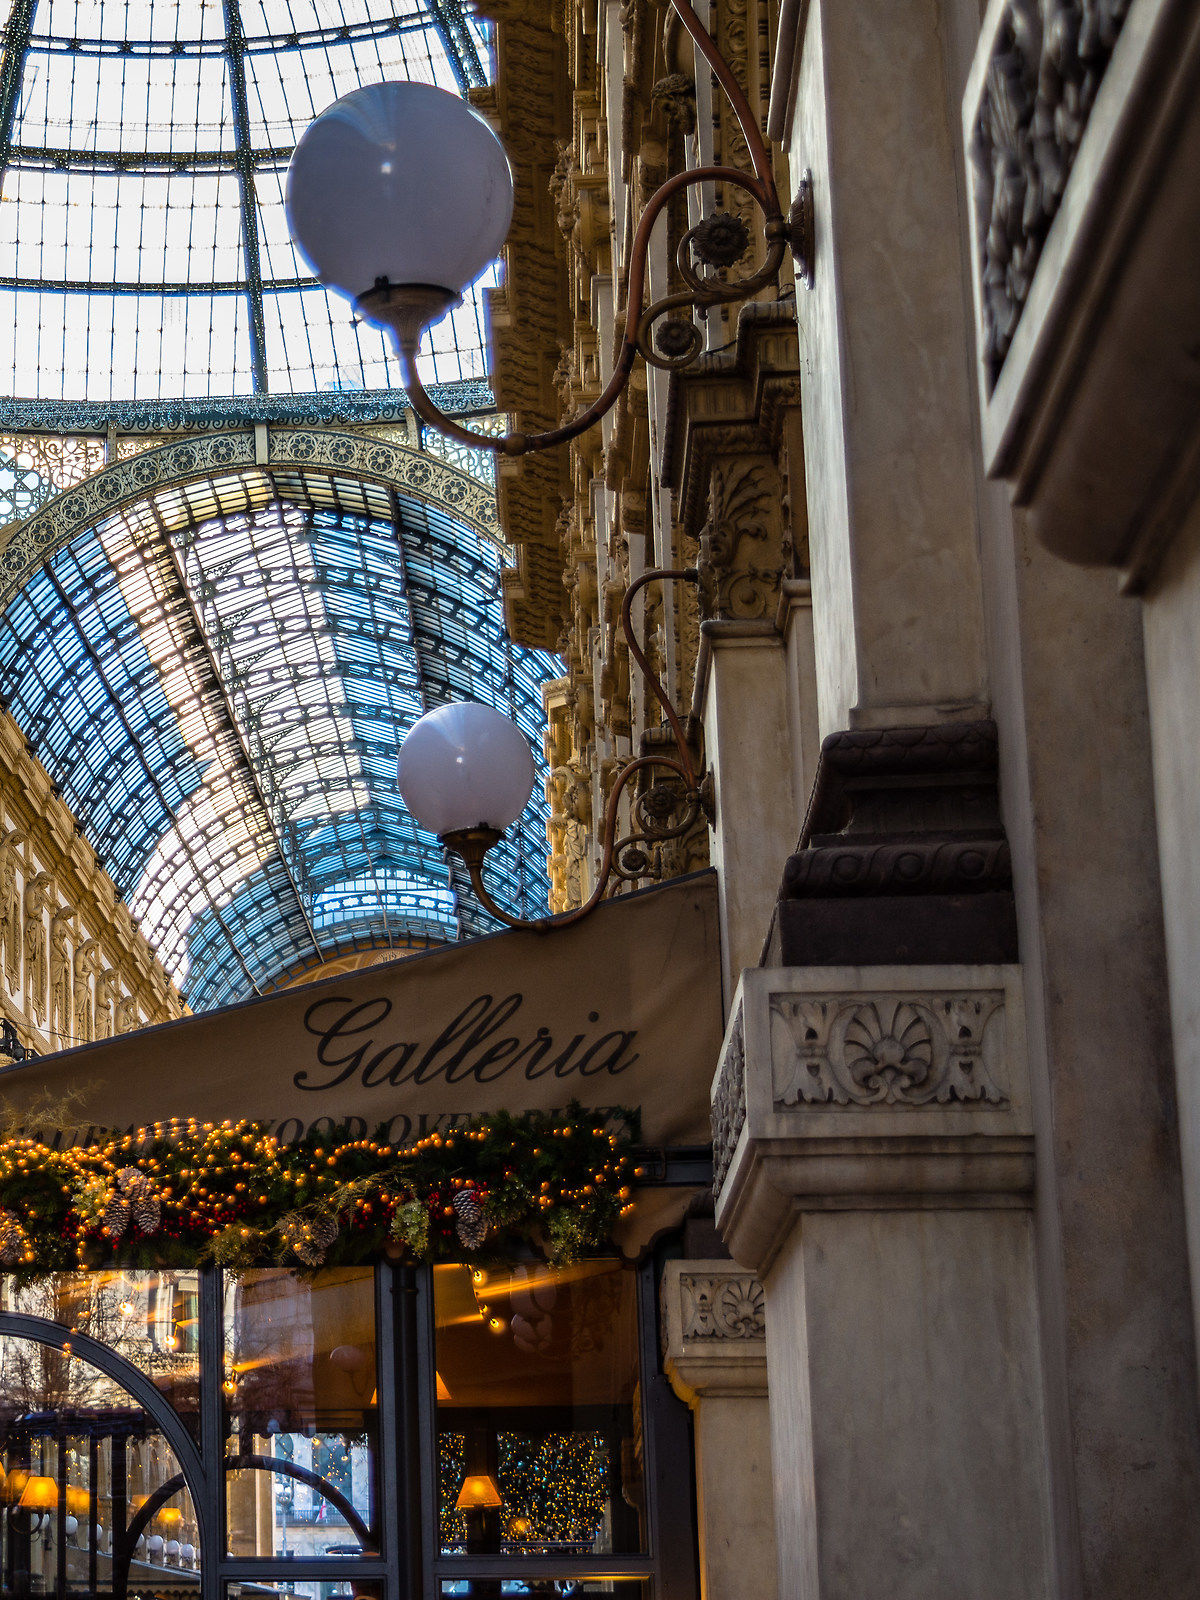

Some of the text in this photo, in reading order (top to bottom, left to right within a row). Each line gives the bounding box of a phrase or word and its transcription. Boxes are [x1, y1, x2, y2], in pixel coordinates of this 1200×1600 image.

[293, 993, 640, 1091] Galleria
[386, 1111, 490, 1146] OVE
[523, 1104, 642, 1143] PZZA
